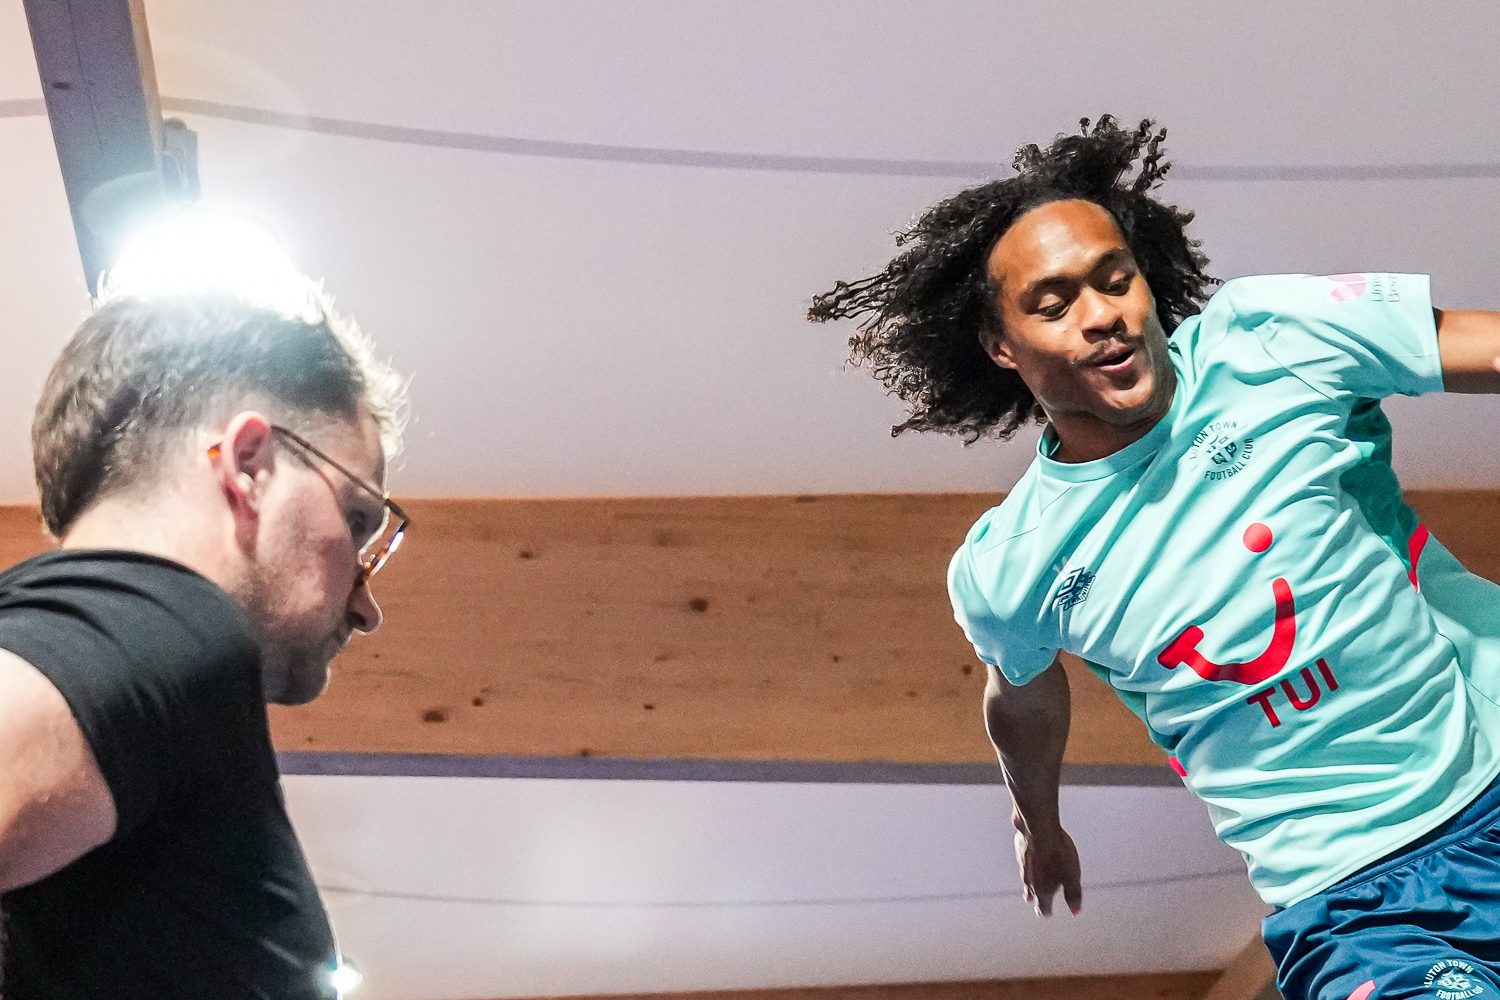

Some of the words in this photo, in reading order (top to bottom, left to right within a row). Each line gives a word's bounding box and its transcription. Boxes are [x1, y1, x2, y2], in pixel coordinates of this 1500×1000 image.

[1189, 430, 1209, 460] LUTON
[1209, 421, 1239, 432] TOWN
[1204, 461, 1246, 480] FOOTBALL
[1247, 658, 1339, 727] TUI
[1424, 961, 1447, 986] LUTON
[1446, 960, 1474, 973] TOWN
[1436, 990, 1474, 1000] FOOTBALL
